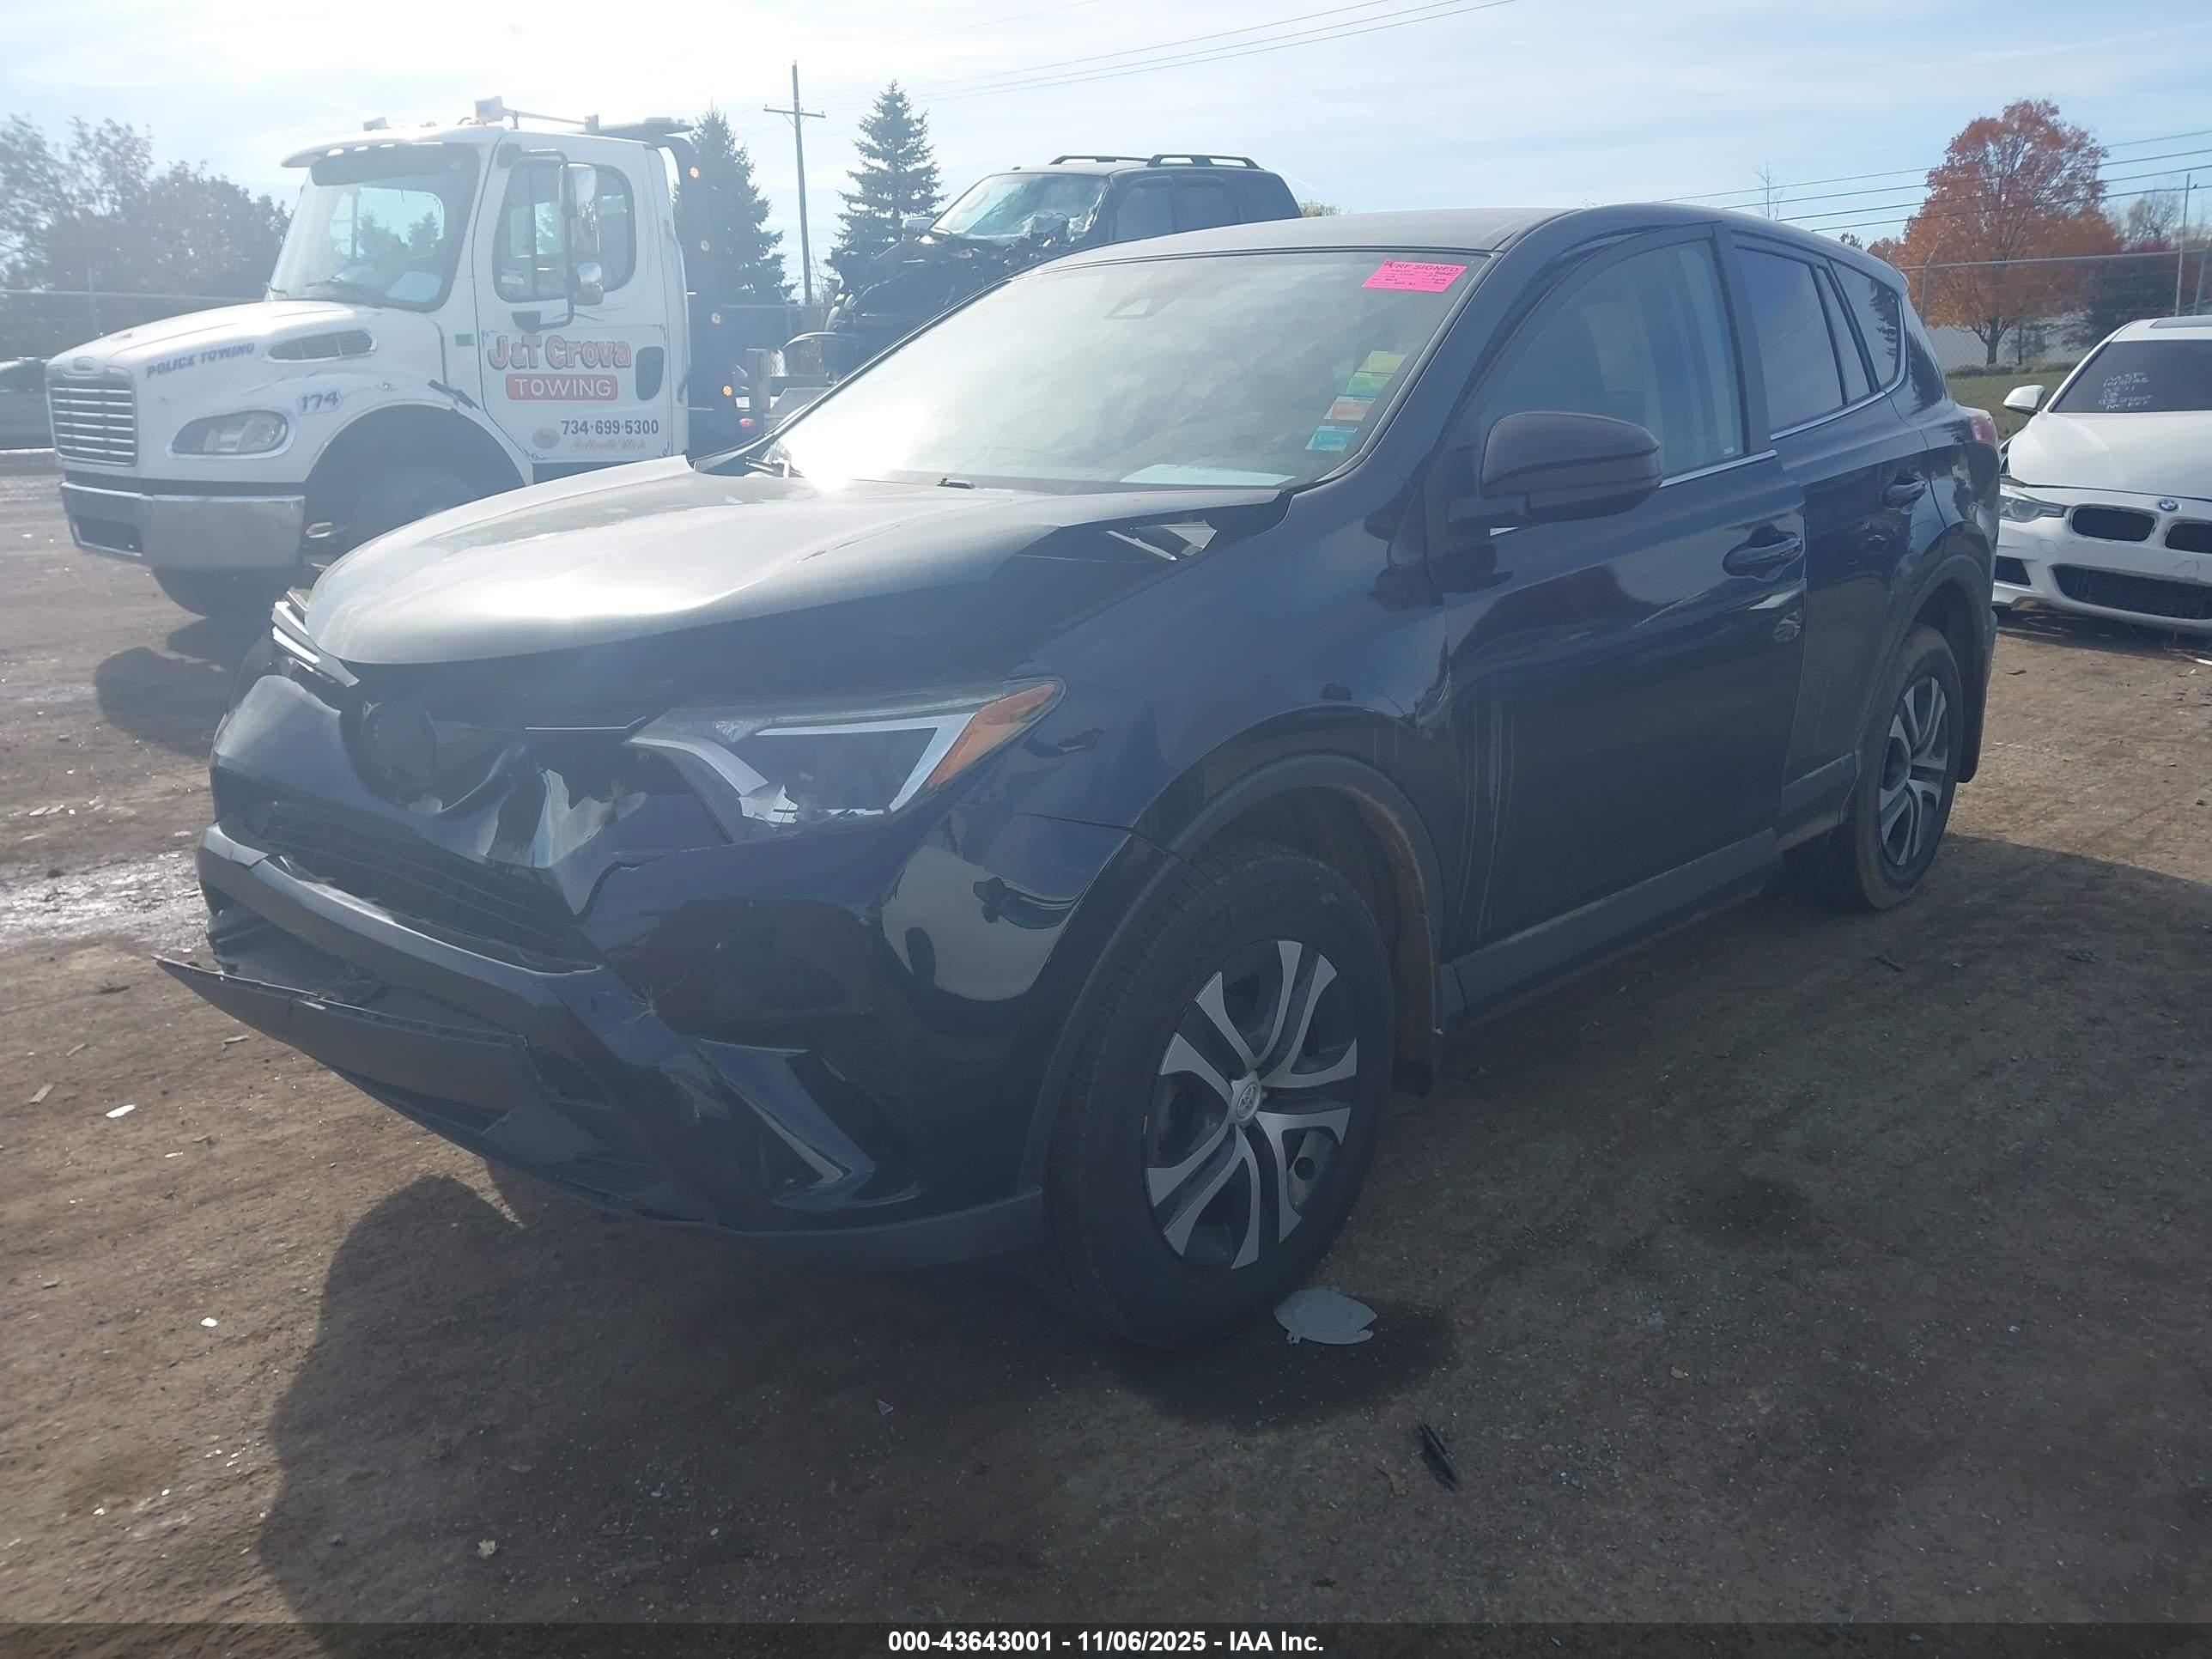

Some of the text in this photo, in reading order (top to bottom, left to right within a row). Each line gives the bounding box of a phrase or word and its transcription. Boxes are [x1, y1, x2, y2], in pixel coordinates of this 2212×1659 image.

[1413, 264, 1459, 272] SIGNED
[146, 342, 256, 378] POLICE TOWING
[487, 335, 632, 370] J&T Crova
[514, 378, 612, 398] TOWING
[300, 390, 340, 412] 174
